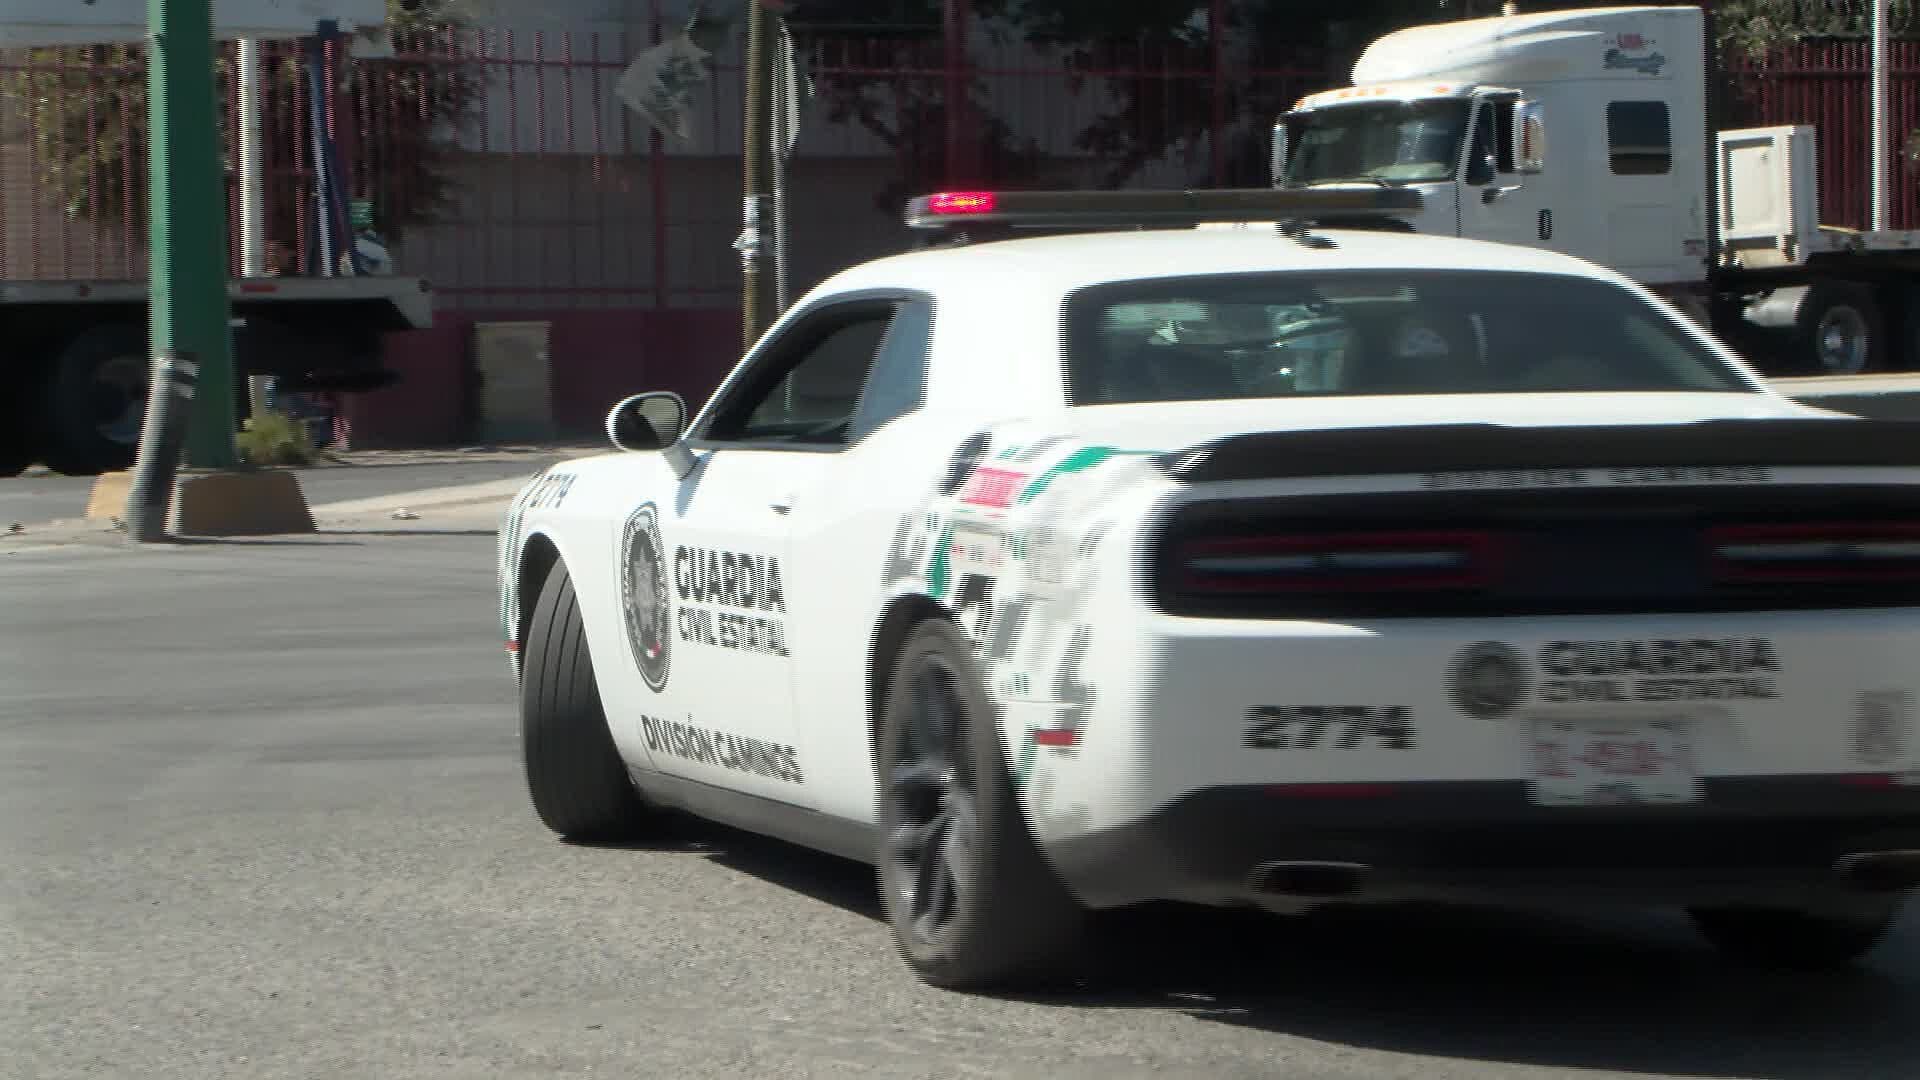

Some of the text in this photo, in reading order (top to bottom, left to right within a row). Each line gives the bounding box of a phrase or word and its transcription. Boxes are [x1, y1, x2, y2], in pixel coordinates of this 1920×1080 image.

[674, 545, 786, 614] GUARDIA
[677, 606, 789, 657] CIVIL ESTATAL
[1538, 637, 1783, 676] GUARDIA
[1537, 677, 1783, 702] CIVIL ESTATAL
[640, 712, 804, 784] DIVISIÓN CAMINOS
[1243, 704, 1418, 750] 2774
